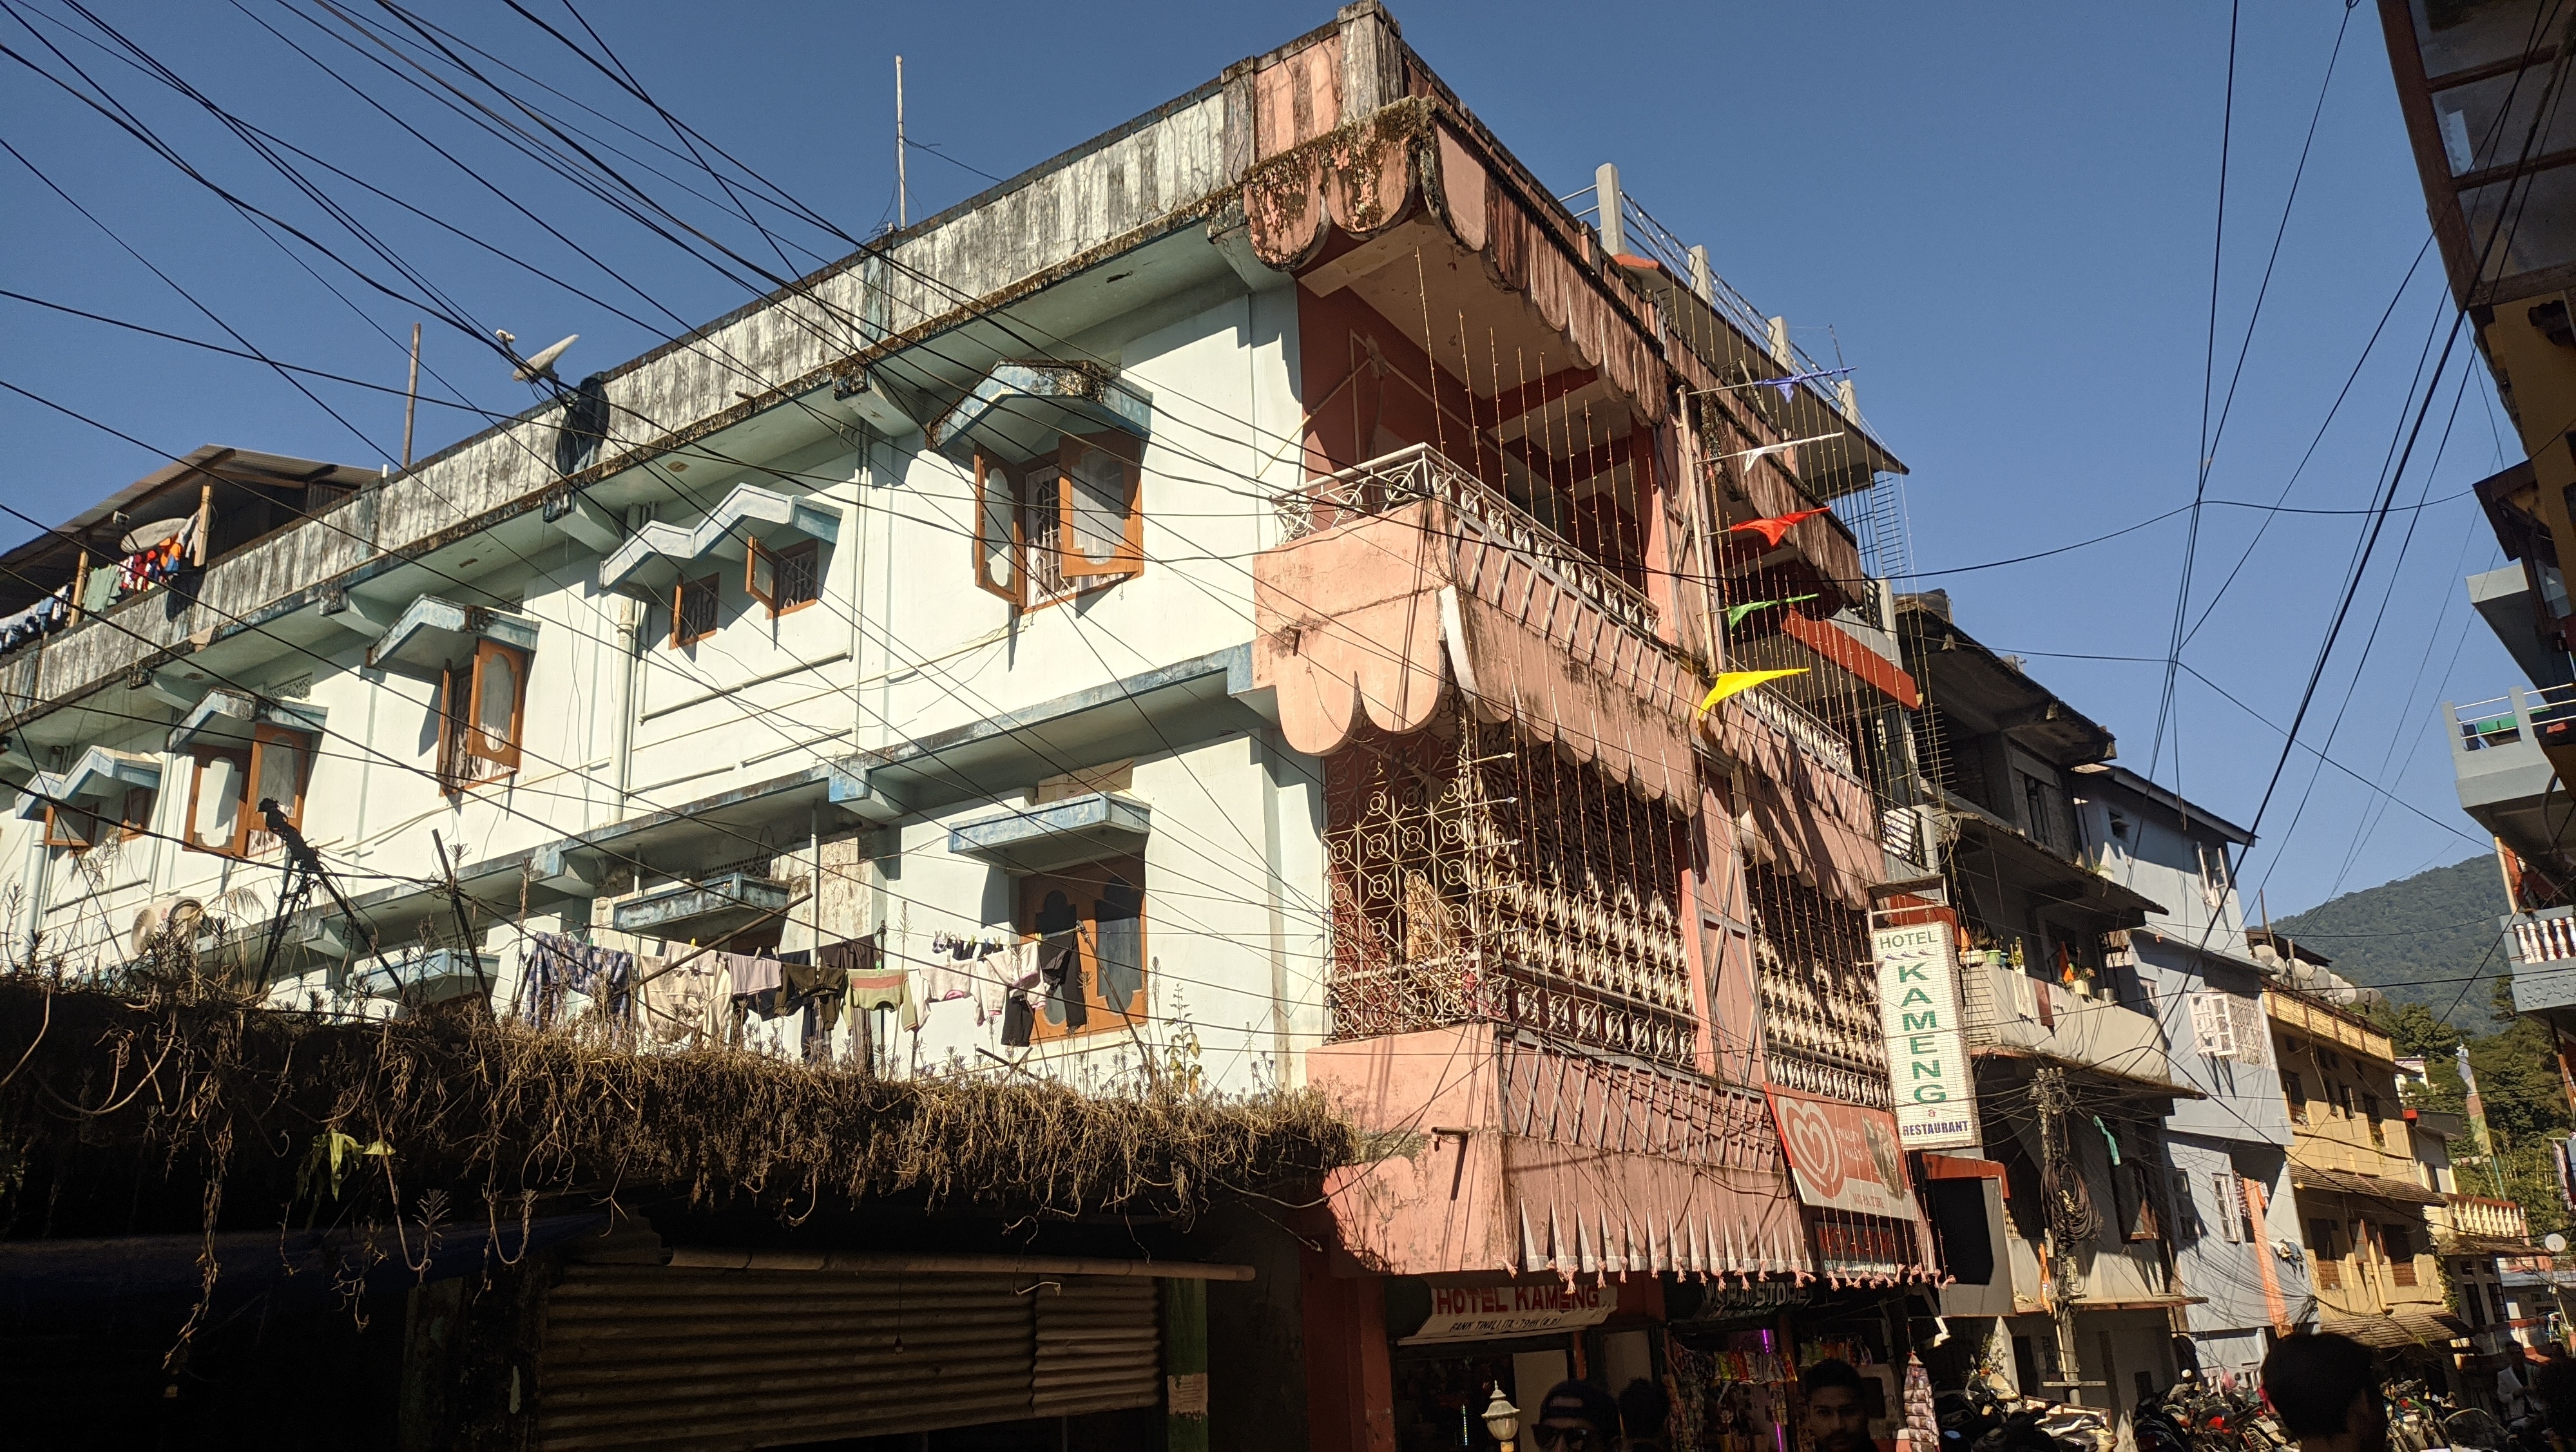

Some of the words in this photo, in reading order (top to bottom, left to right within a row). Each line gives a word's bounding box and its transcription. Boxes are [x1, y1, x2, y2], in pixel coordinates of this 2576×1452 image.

[1879, 931, 1937, 950] HOTEL
[1898, 962, 1946, 1104] KAMENG
[1928, 1109, 1936, 1118] &
[1902, 1120, 1968, 1136] RESTAURANT
[1436, 1288, 1508, 1315] HOTEL
[1515, 1286, 1599, 1312] KAMENG
